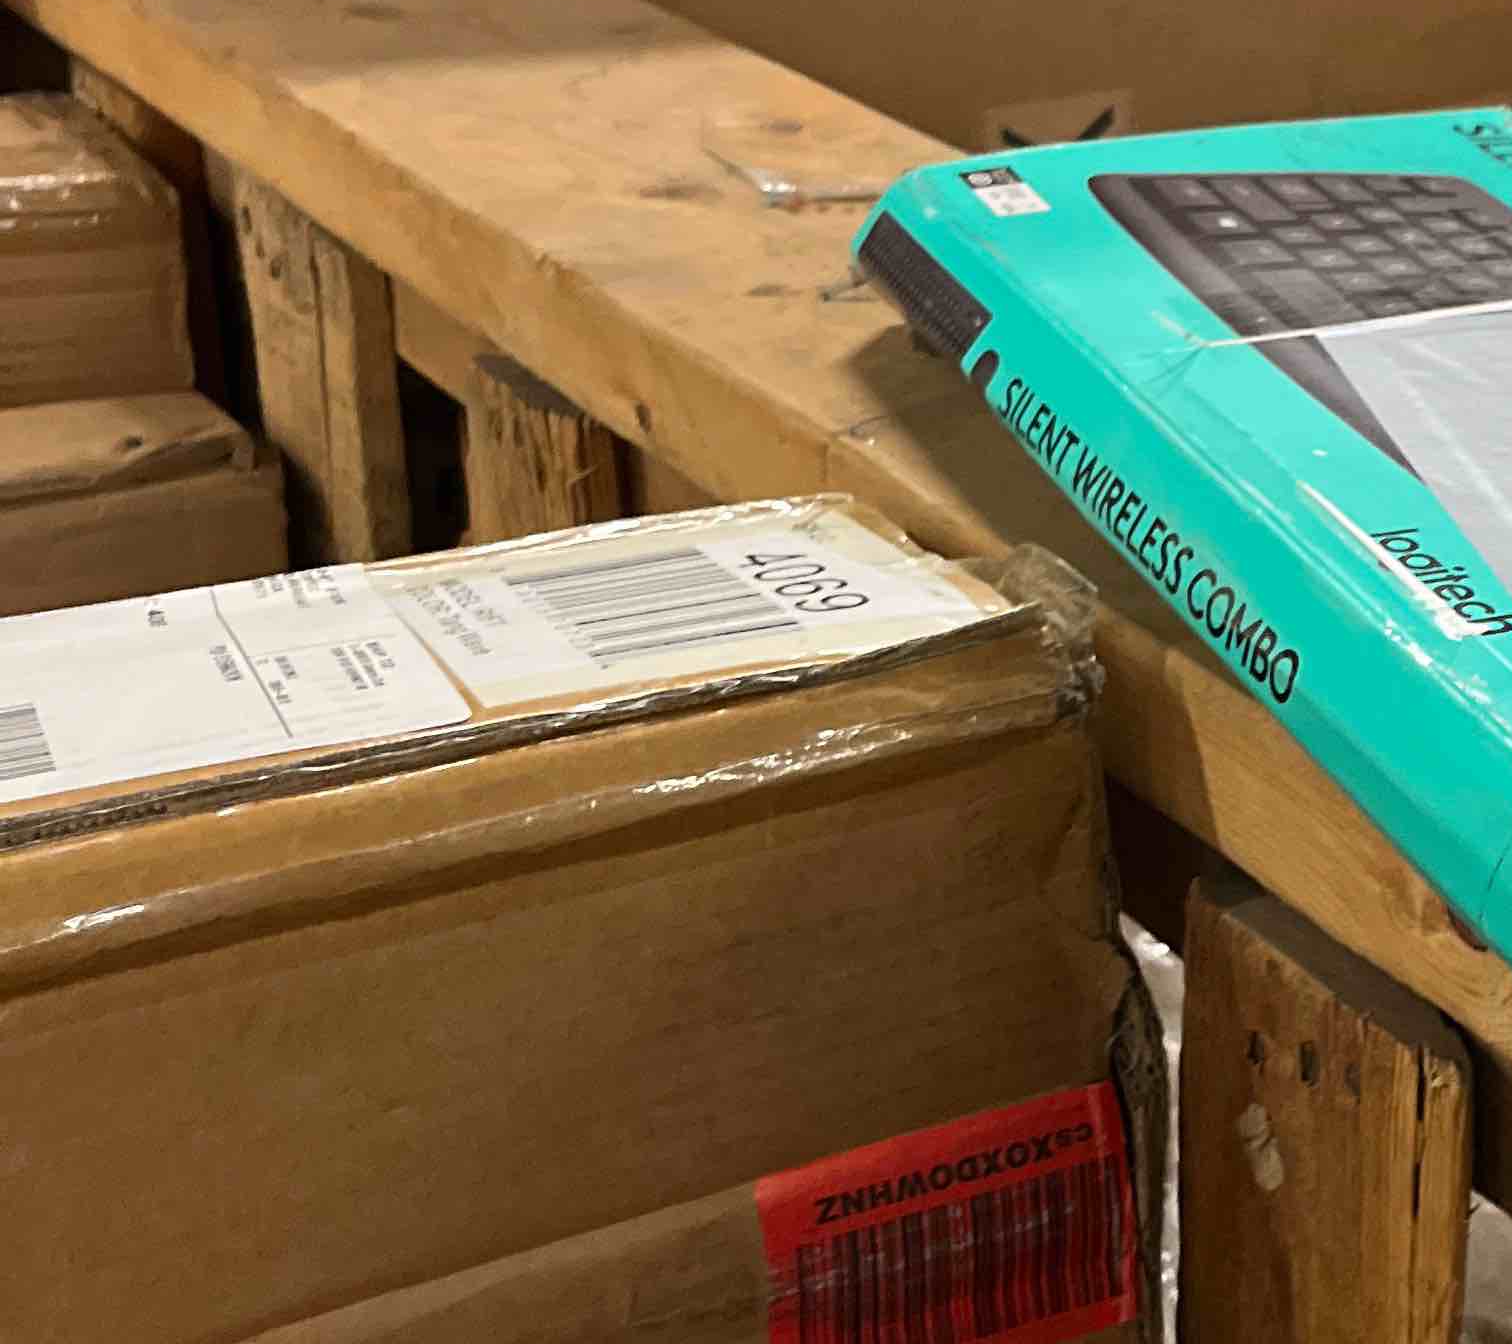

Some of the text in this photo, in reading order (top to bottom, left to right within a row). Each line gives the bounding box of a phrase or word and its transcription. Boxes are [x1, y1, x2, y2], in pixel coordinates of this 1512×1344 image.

[738, 554, 871, 613] 4069
[1000, 377, 1300, 704] SILENT WIRELESS COMBO
